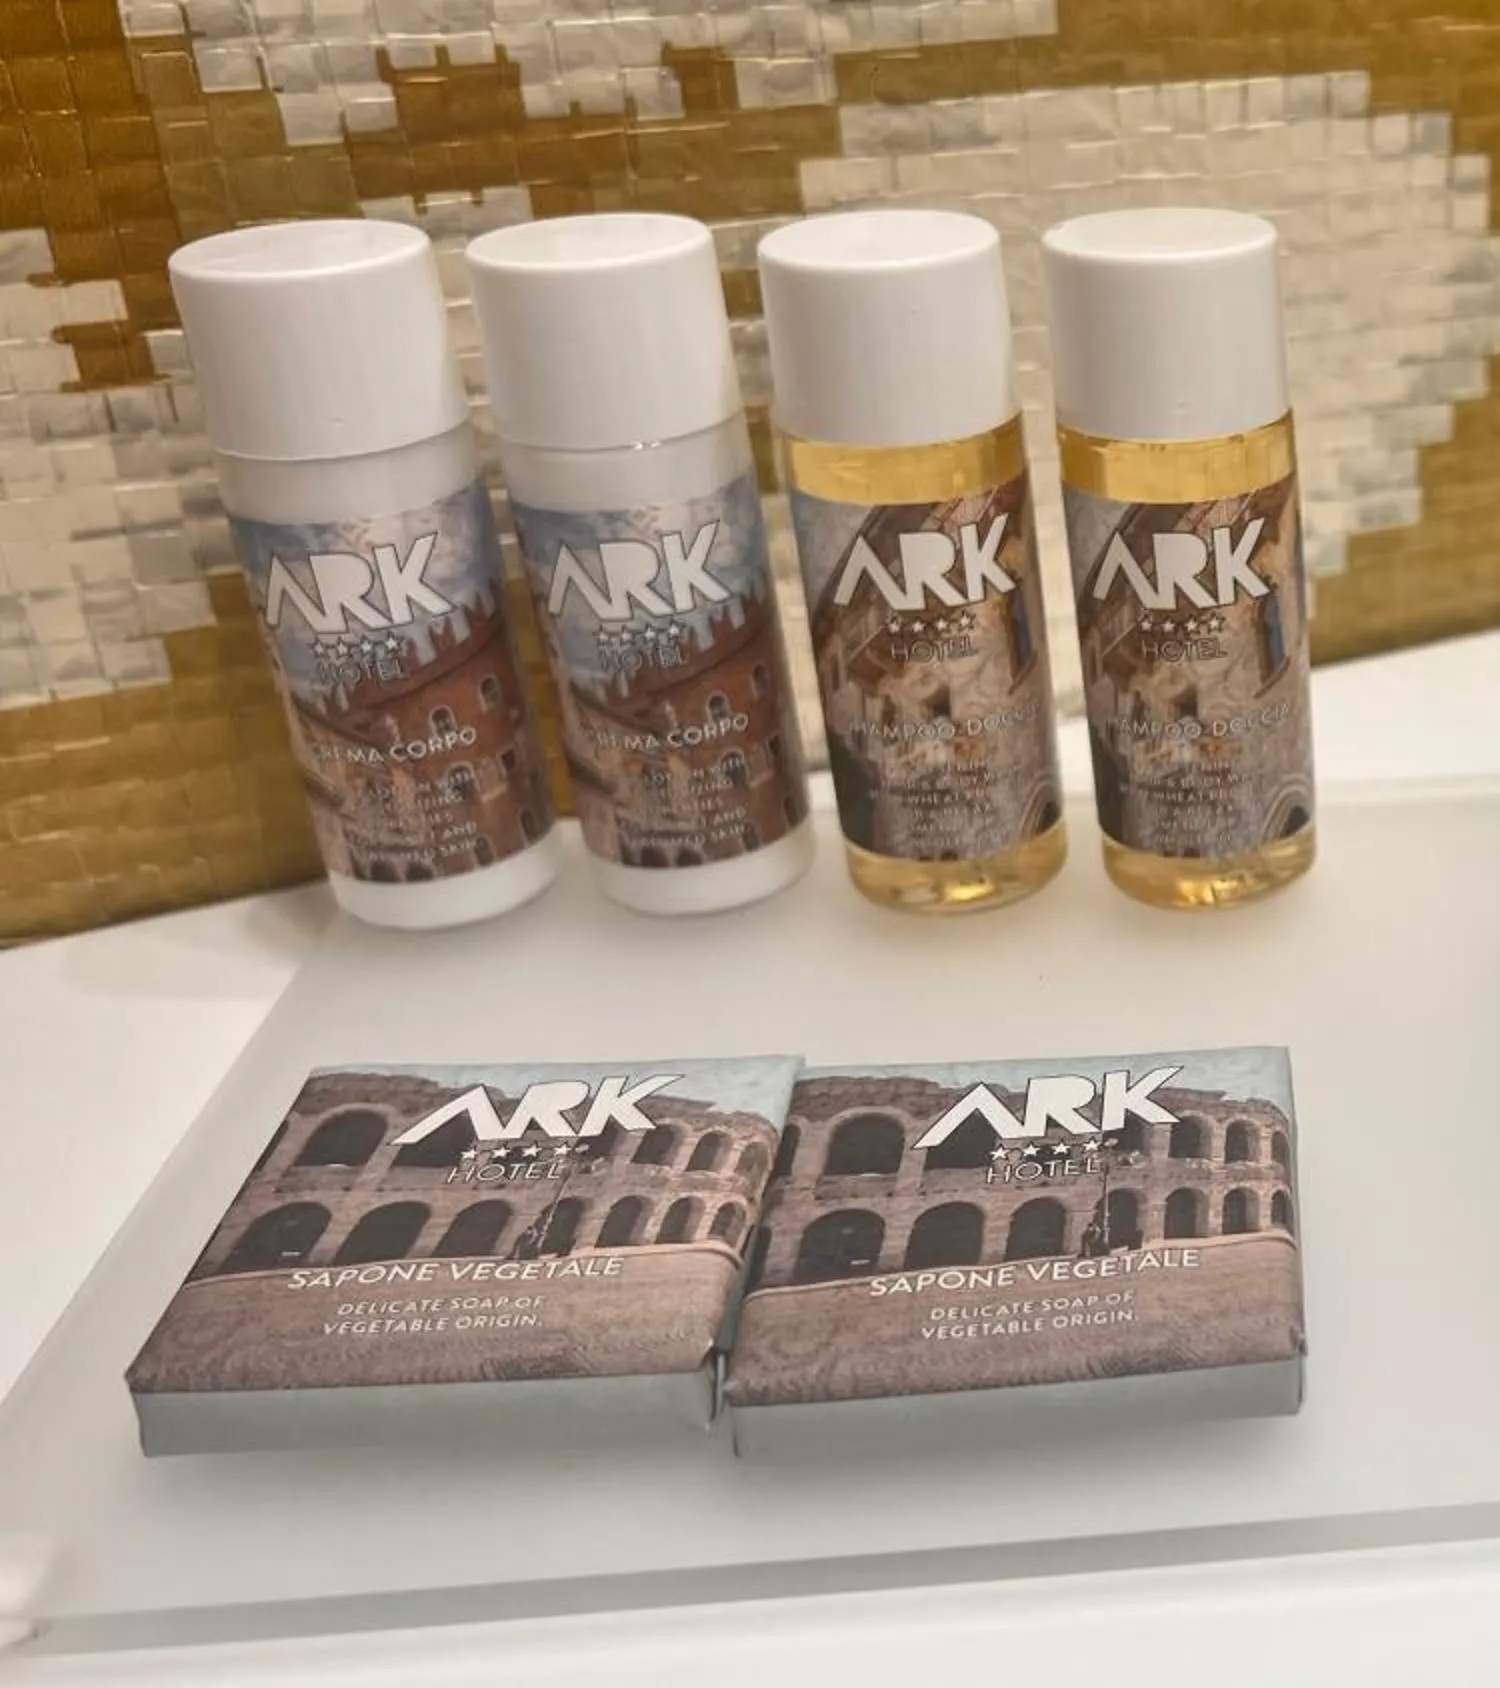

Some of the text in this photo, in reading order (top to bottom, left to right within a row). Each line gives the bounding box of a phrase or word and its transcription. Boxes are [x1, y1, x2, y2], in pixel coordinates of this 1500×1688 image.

[546, 518, 731, 621] ARK
[834, 512, 1017, 611] ARK
[1092, 517, 1271, 610] ARK
[265, 531, 455, 634] ARK
[890, 636, 978, 662] HOTEL
[1139, 637, 1229, 662] HOTEL
[390, 725, 477, 762] CORPO
[667, 712, 749, 748] CORPO
[387, 1073, 688, 1146] ARK
[911, 1064, 1185, 1150] ARK
[447, 1161, 564, 1185] HOTEL
[984, 1157, 1101, 1185] HOTEL
[287, 1256, 626, 1290] SAPONE VEGETALE
[869, 1249, 1200, 1297] SAPONE VEGETALE
[337, 1295, 544, 1317] DELICATE SOAP OF
[930, 1290, 1135, 1322] DELICATE SOAP OF
[323, 1313, 543, 1336] VEGETABLE ORIGIN.
[921, 1309, 1139, 1341] VEGETABLE ORIGIN.
